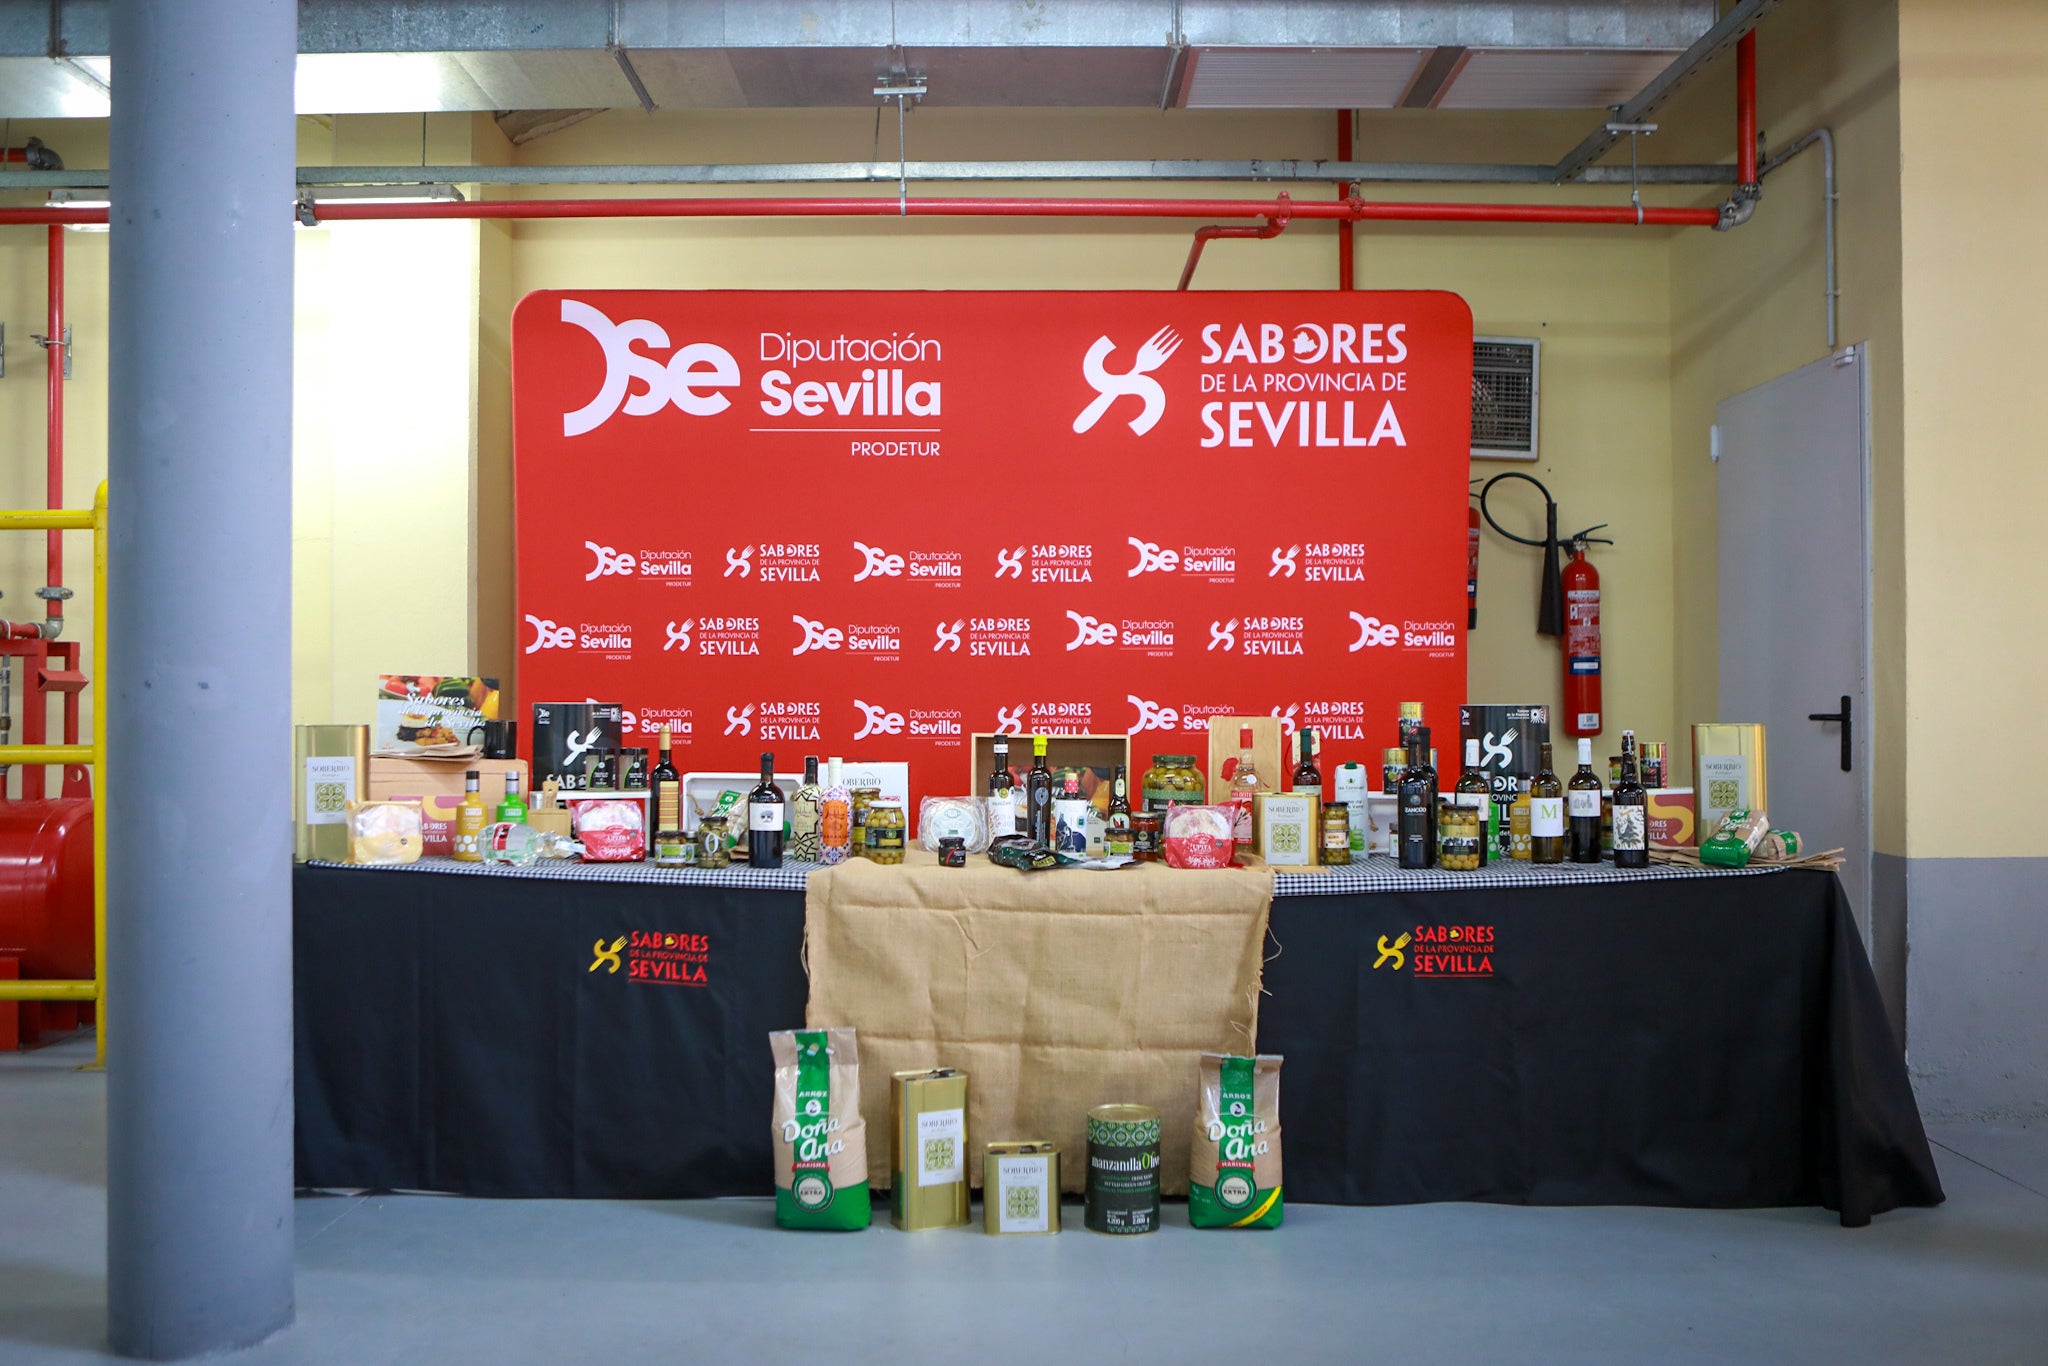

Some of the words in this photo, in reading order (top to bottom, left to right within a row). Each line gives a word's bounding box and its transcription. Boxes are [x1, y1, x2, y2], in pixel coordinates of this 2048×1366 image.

[760, 332, 941, 368] Diputación
[1201, 323, 1407, 364] SABORES
[1201, 373, 1226, 392] DE
[1233, 373, 1257, 392] LA
[1264, 373, 1376, 392] PROVINCIA
[1382, 373, 1407, 392] DE
[760, 369, 941, 416] Sevilla
[1201, 400, 1407, 447] SEVILLA
[851, 441, 941, 456] PRODETUR
[641, 550, 691, 560] Diputación
[760, 544, 819, 557] SABORES
[910, 551, 961, 561] Diputación
[1032, 545, 1092, 558] SABORES
[1184, 547, 1235, 556] Diputación
[1306, 544, 1364, 556] SABORES
[641, 561, 691, 575] Sevilla
[760, 558, 767, 566] DE
[769, 558, 776, 566] LA
[778, 558, 810, 566] PROVINCIA
[812, 558, 819, 566] DE
[1032, 559, 1039, 567] DE
[1041, 559, 1048, 567] LA
[1050, 559, 1082, 567] PROVINCIA
[1084, 559, 1091, 567] DE
[1184, 557, 1235, 571] Sevilla
[1306, 557, 1313, 566] DE
[1314, 557, 1322, 566] LA
[1323, 557, 1355, 566] PROVINCIA
[1356, 557, 1363, 566] DE
[761, 567, 820, 581] SEVILLA
[910, 562, 961, 576] Sevilla
[1032, 568, 1092, 582] SEVILLA
[1306, 567, 1364, 581] SEVILLA
[581, 624, 631, 634] Diputación
[700, 618, 759, 630] SABORES
[849, 625, 899, 634] Diputación
[971, 618, 1030, 631] SABORES
[1123, 620, 1173, 630] Diputación
[1244, 617, 1303, 630] SABORES
[1405, 621, 1454, 631] Diputación
[581, 635, 631, 648] Sevilla
[700, 631, 707, 640] DE
[709, 631, 716, 640] LA
[717, 631, 750, 640] PROVINCIA
[751, 631, 758, 640] DE
[970, 632, 977, 640] DE
[979, 632, 986, 640] LA
[988, 632, 1020, 640] PROVINCIA
[1022, 632, 1029, 640] DE
[1123, 631, 1173, 645] Sevilla
[1244, 631, 1251, 639] DE
[1253, 631, 1260, 639] LA
[1261, 631, 1294, 639] PROVINCIA
[1295, 631, 1302, 639] DE
[1405, 632, 1454, 646] Sevilla
[700, 641, 759, 655] SEVILLA
[849, 635, 899, 650] Sevilla
[971, 642, 1030, 655] SEVILLA
[1244, 641, 1303, 654] SEVILLA
[405, 691, 465, 706] Sabores
[641, 708, 692, 718] Diputación
[761, 703, 820, 715] SABORES
[910, 709, 961, 719] Diputación
[1032, 703, 1091, 716] SABORES
[1184, 705, 1234, 714] Diputación
[1305, 702, 1363, 714] SABORES
[641, 719, 692, 733] Seilla
[761, 716, 768, 724] DE
[770, 716, 777, 724] LA
[778, 716, 811, 724] PROVINCIA
[812, 716, 819, 724] DE
[1032, 717, 1039, 725] DE
[1041, 717, 1048, 725] LA
[1049, 717, 1082, 725] PROVINCIA
[1083, 717, 1090, 725] DE
[1305, 716, 1312, 724] DE
[1314, 716, 1321, 724] LA
[1322, 716, 1355, 724] PROVINCIA
[1356, 716, 1363, 724] DE
[761, 726, 820, 740] SEVILLA
[910, 720, 961, 734] Sevilla
[842, 778, 882, 787] OBERBIO
[1491, 794, 1518, 802] OVINC
[1541, 803, 1557, 819] M
[423, 834, 448, 843] VILLA
[1648, 832, 1668, 840] ILLA
[630, 930, 709, 951] SABORES
[1414, 925, 1495, 943] SABORES
[1414, 944, 1424, 953] DE
[1426, 944, 1436, 953] LA
[1438, 944, 1483, 953] PROVINCIA
[1483, 944, 1495, 953] DE
[630, 949, 640, 958] DE
[641, 950, 653, 959] LA
[652, 951, 697, 962] PROVINCIA
[1413, 955, 1494, 972] SEVILLA
[629, 959, 708, 982] SEVILLA
[1222, 1092, 1252, 1100] ARROZ
[781, 1118, 840, 1143] Doña
[1205, 1120, 1267, 1142] Doña
[800, 1138, 845, 1162] Ana
[1225, 1138, 1269, 1160] Ana
